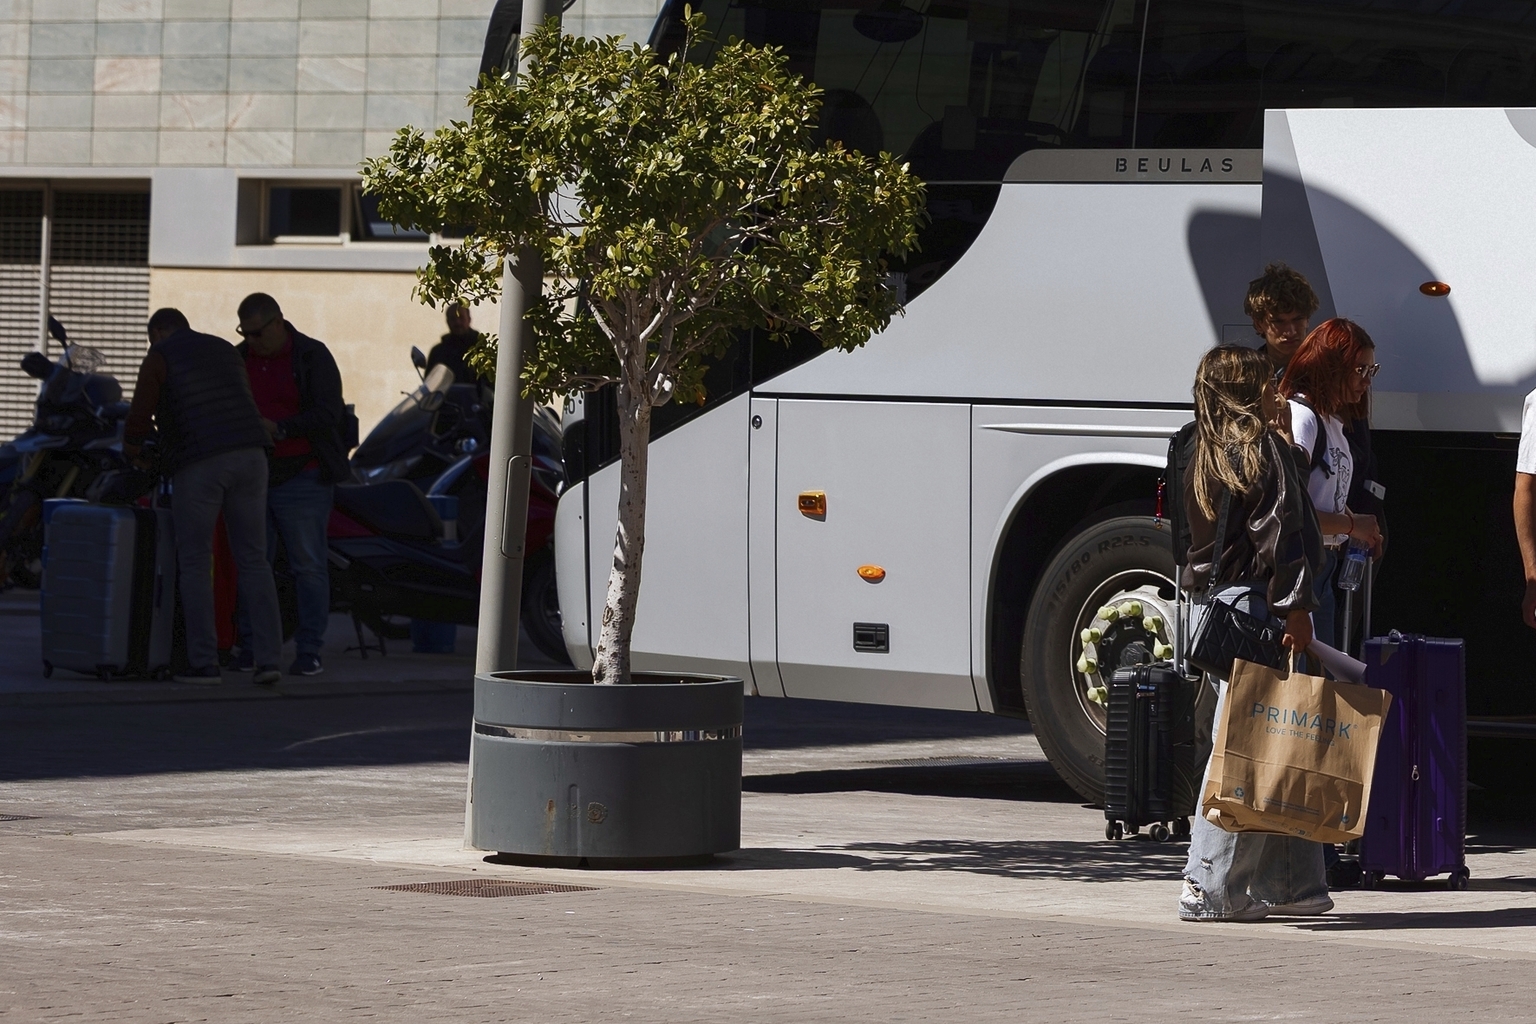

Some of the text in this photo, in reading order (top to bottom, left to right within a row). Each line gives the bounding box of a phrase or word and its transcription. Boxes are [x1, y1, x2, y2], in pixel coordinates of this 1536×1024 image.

[1115, 158, 1233, 173] BEULAS
[1252, 702, 1352, 740] PRIMARK
[1265, 726, 1287, 736] LOVE
[1289, 729, 1304, 739] THE
